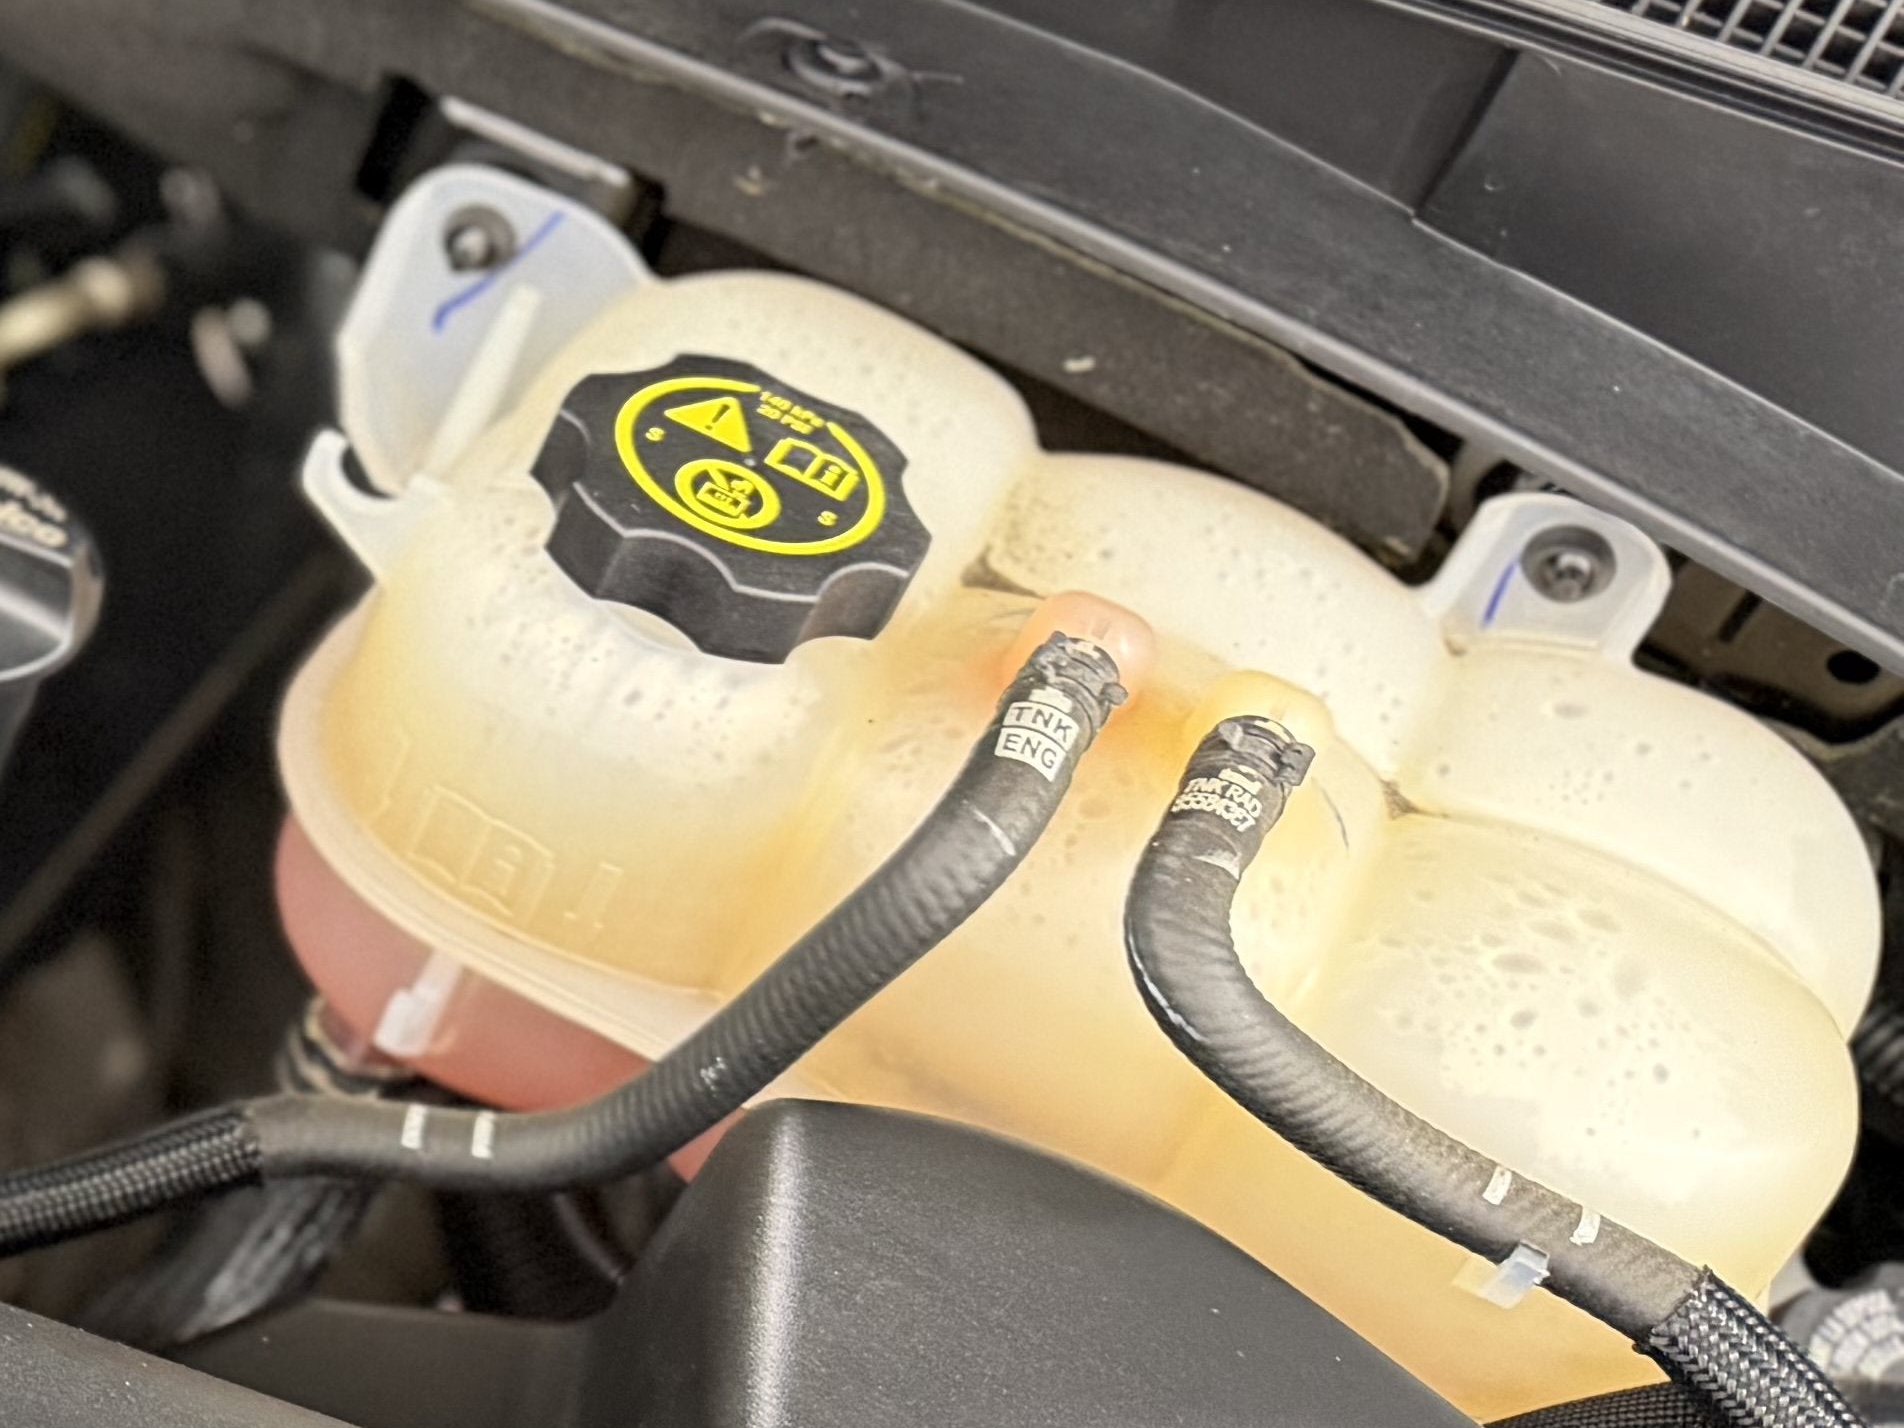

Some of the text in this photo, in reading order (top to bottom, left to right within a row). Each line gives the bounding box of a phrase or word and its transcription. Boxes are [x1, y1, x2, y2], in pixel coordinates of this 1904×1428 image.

[1011, 706, 1075, 750] TNK
[1002, 734, 1059, 770] ENG
[1225, 784, 1263, 818] RAD
